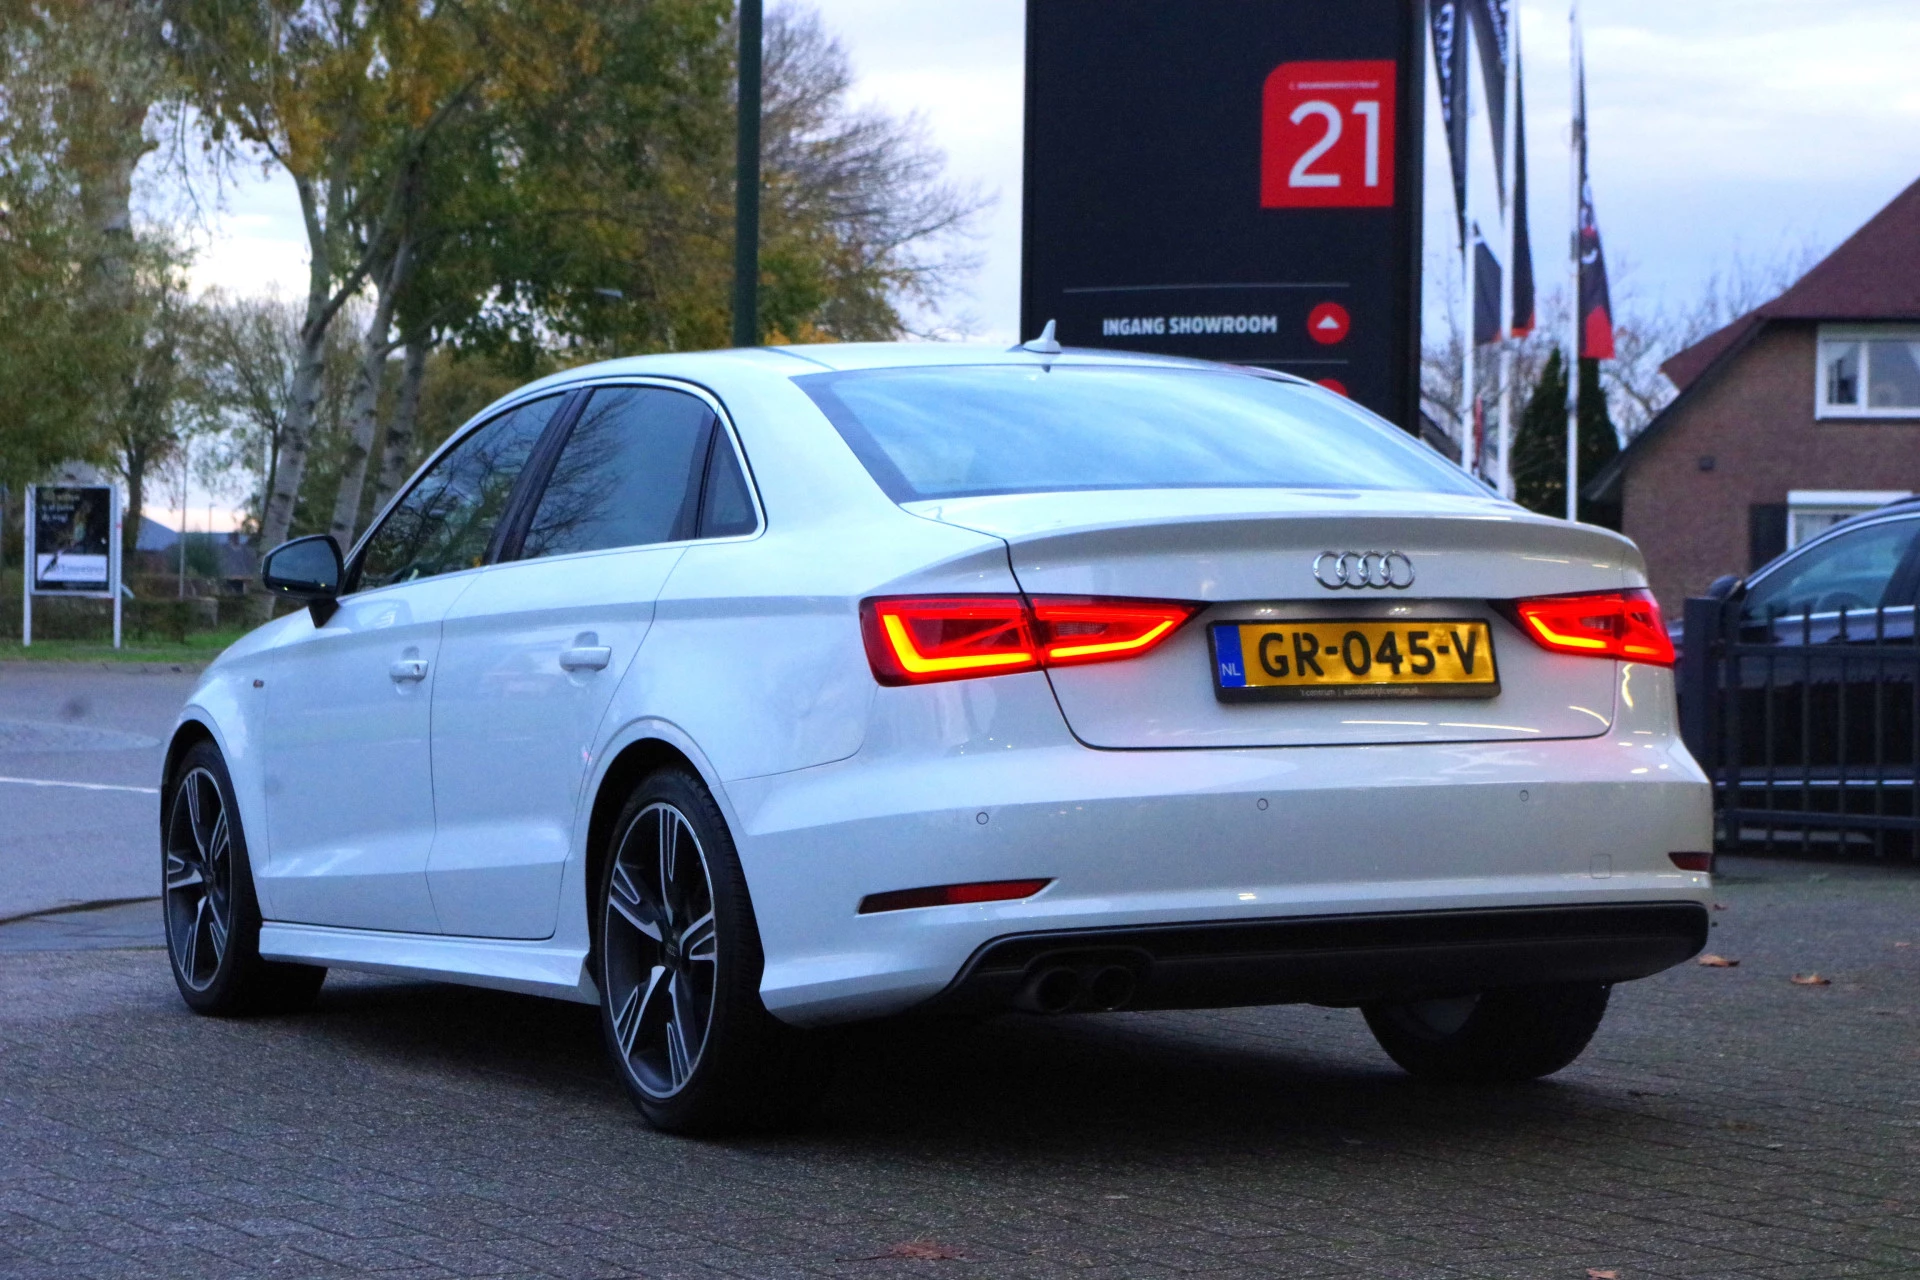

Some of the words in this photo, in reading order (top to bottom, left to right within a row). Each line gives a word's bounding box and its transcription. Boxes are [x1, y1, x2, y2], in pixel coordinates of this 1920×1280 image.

[1288, 100, 1379, 187] 21
[1103, 317, 1165, 336] INGANG
[1169, 315, 1278, 334] SHOWROOM
[1221, 663, 1241, 676] NL
[1258, 630, 1477, 678] GR-045-V
